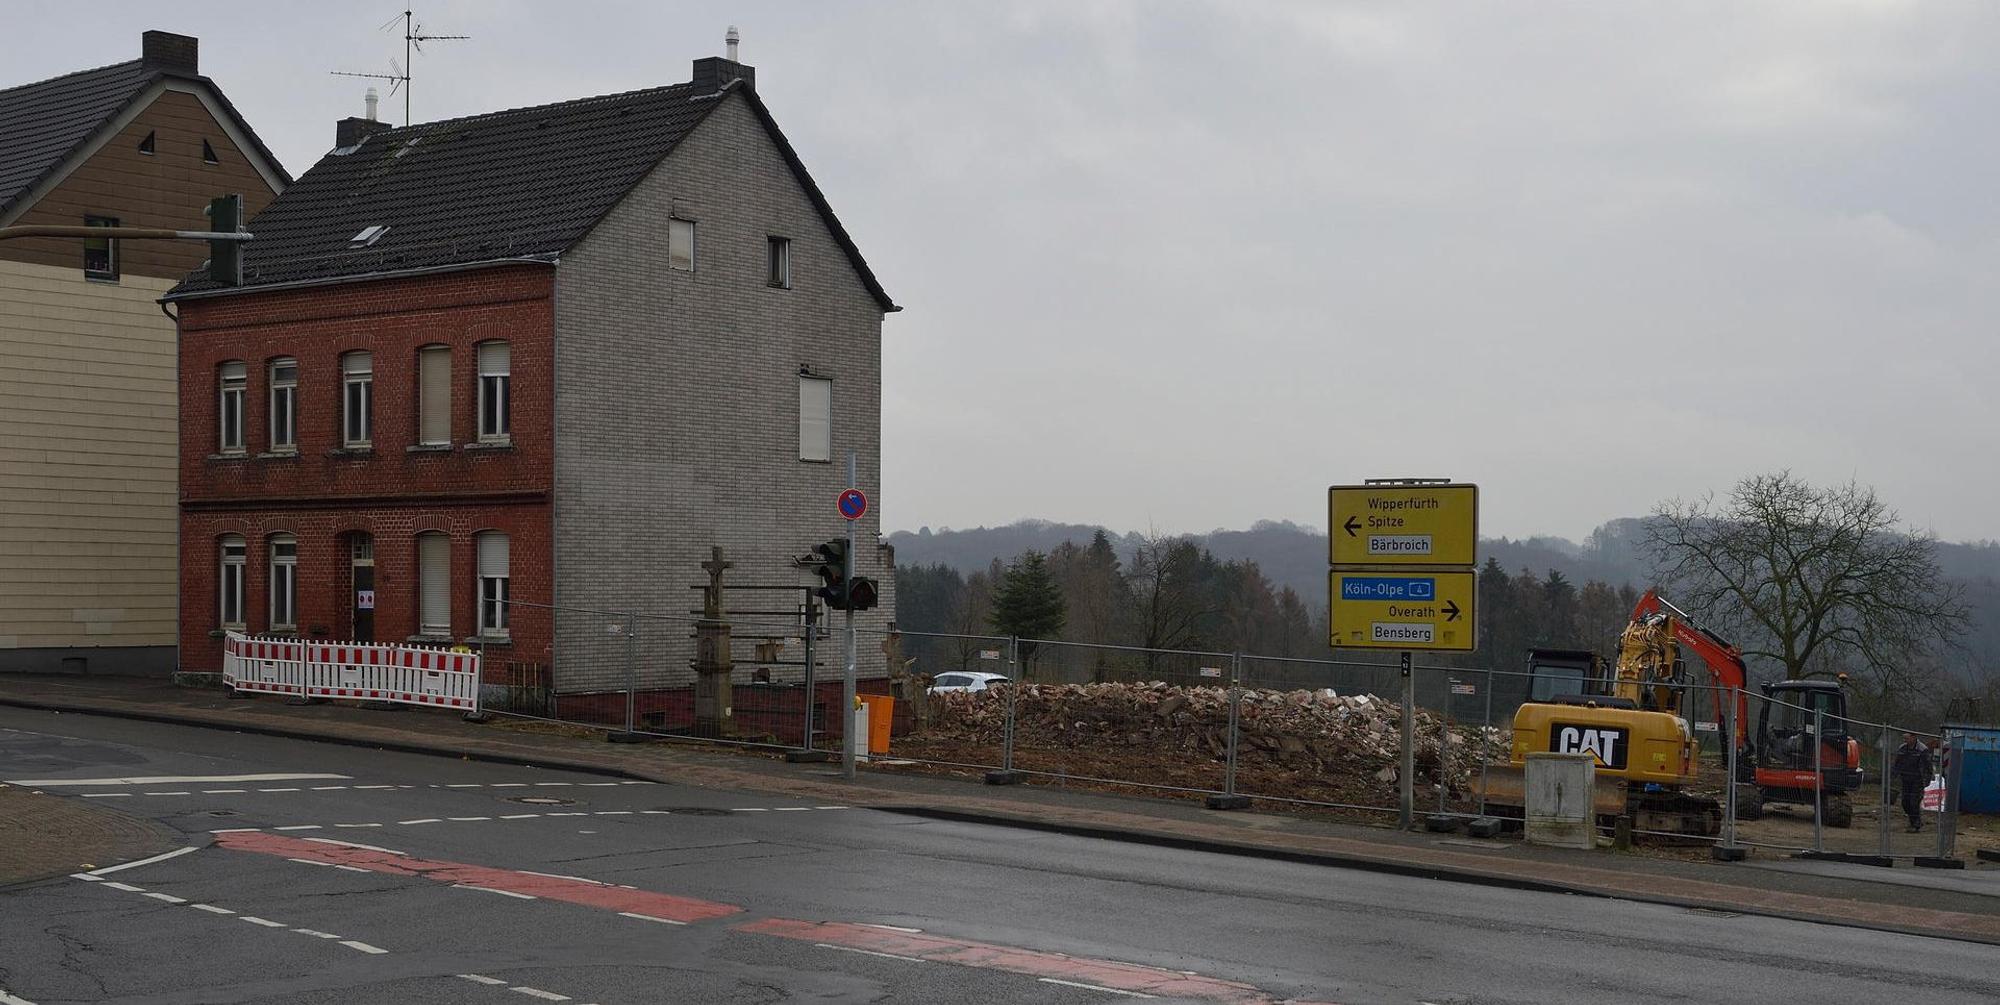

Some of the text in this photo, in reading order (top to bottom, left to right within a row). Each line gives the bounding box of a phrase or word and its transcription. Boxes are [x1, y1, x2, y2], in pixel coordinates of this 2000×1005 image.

[1368, 497, 1439, 511] Wipperfürth
[1368, 515, 1404, 530] Spitze
[1371, 539, 1429, 551] Bärbroich
[1345, 583, 1404, 597] Köln-Olpe
[1389, 605, 1435, 618] Overath
[1375, 627, 1431, 641] Bensberg
[1560, 727, 1619, 766] CAT
